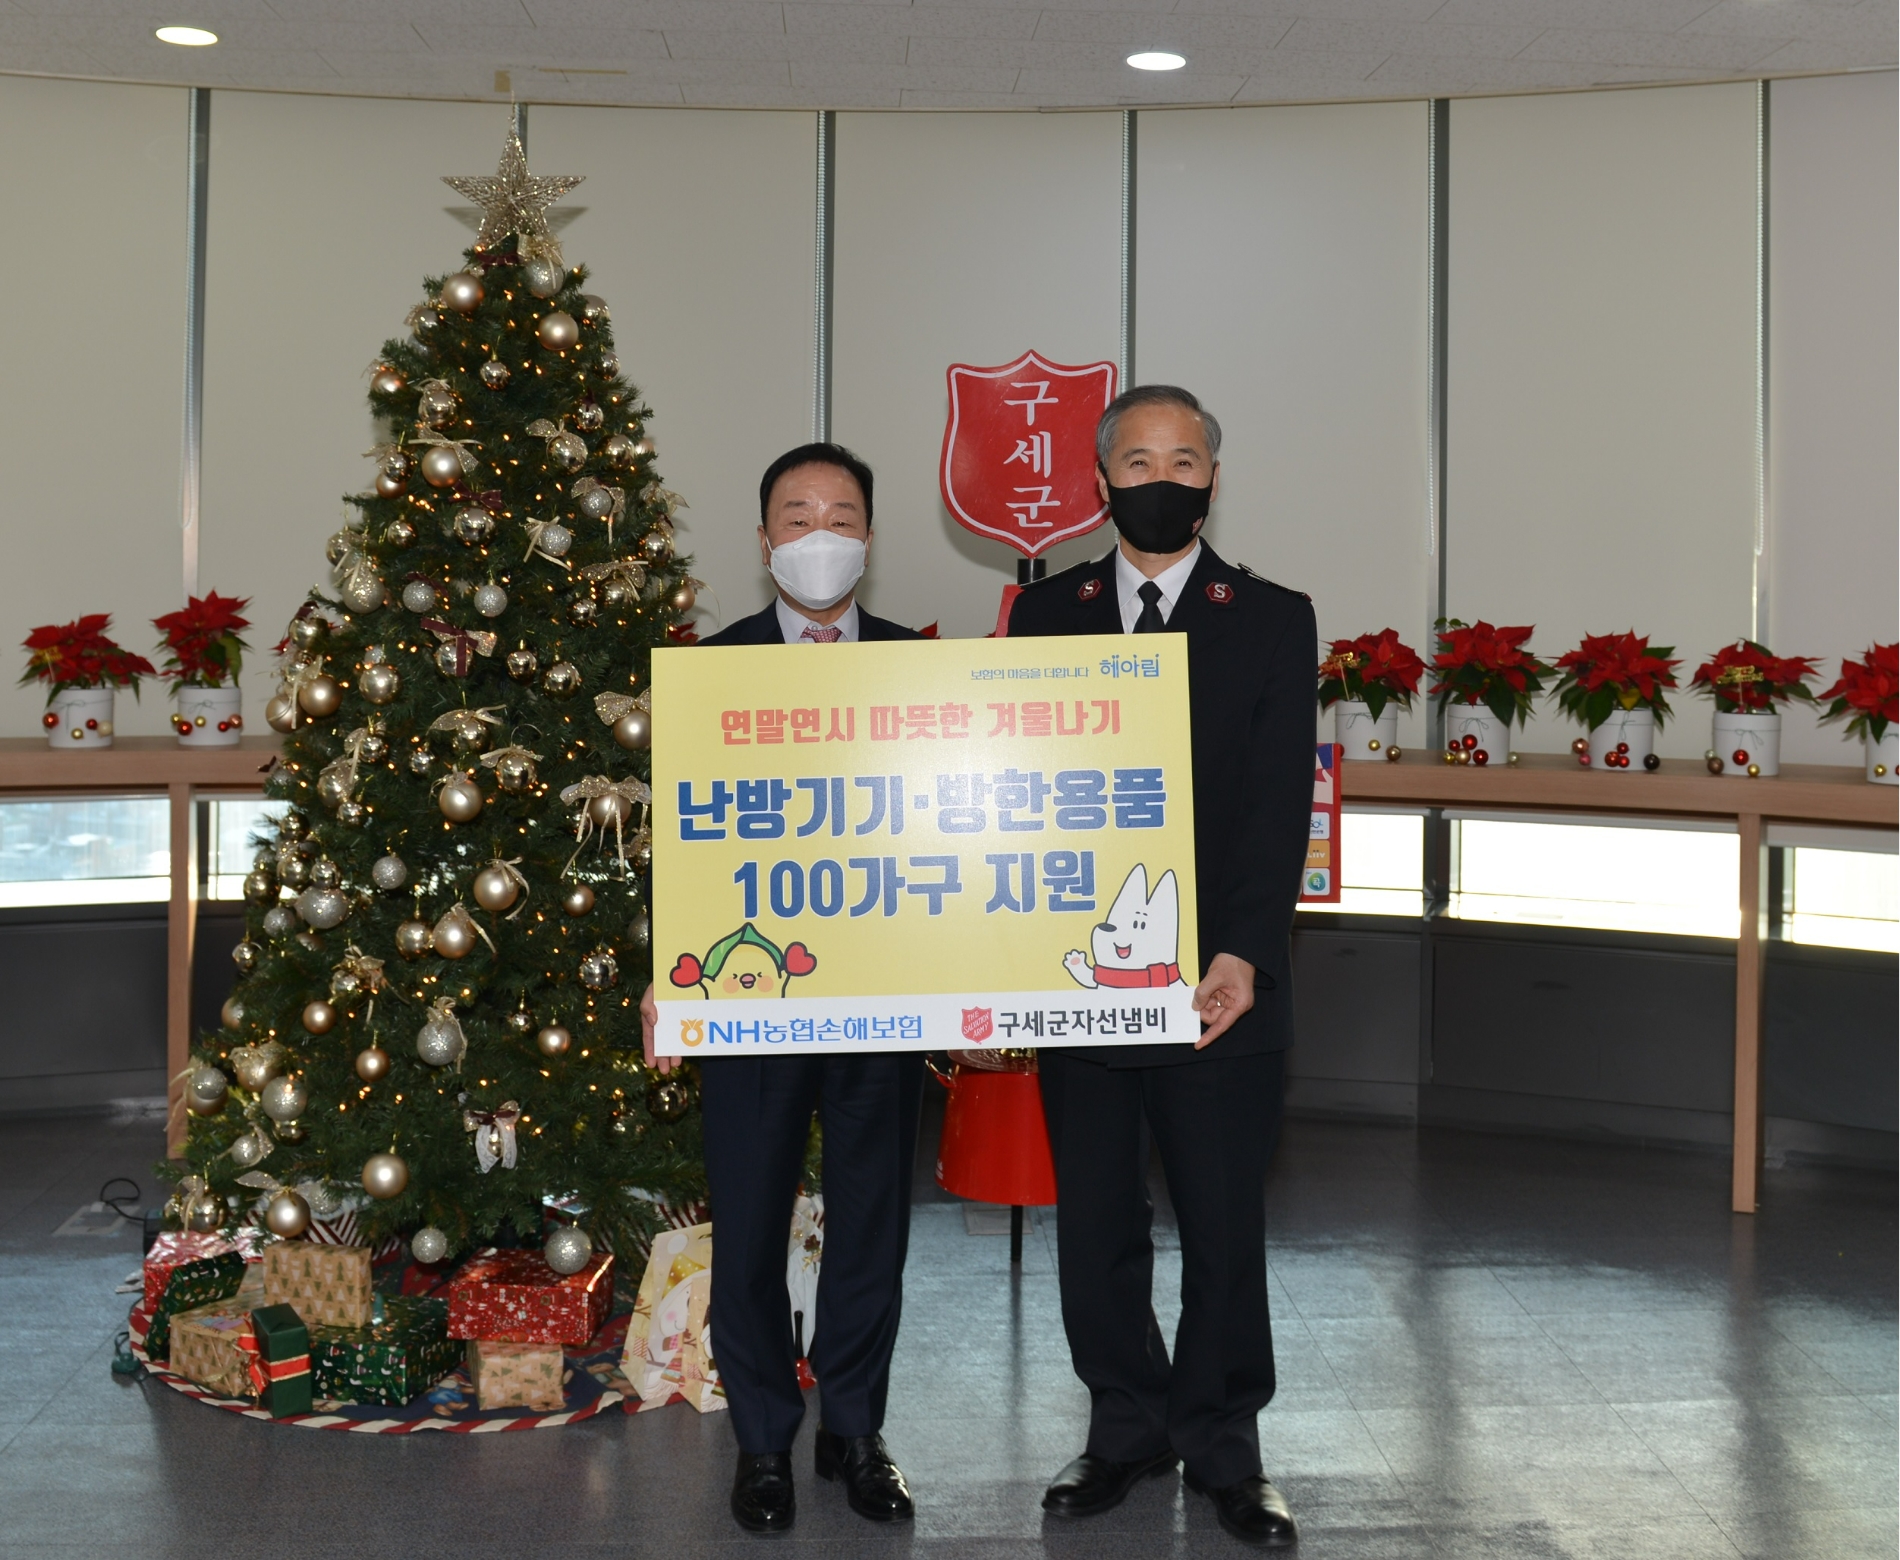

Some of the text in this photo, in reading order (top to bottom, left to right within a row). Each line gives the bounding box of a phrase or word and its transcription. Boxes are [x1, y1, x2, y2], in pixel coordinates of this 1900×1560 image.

[1003, 380, 1061, 527] 구세군
[1083, 580, 1095, 597] S
[1213, 583, 1226, 599] S
[970, 666, 1089, 680] 보험의 마음을 더합니다
[1099, 653, 1160, 678] 헤아림
[720, 699, 1121, 746] 연말연시 따뜻한 겨울나기
[732, 850, 1097, 919] 100가구 지원
[963, 1011, 990, 1035] SALVATION
[967, 1010, 980, 1022] THE
[997, 1006, 1167, 1038] 구세군자선냄비
[708, 1015, 922, 1044] NH농협손해보험
[973, 1021, 989, 1038] ARMY
